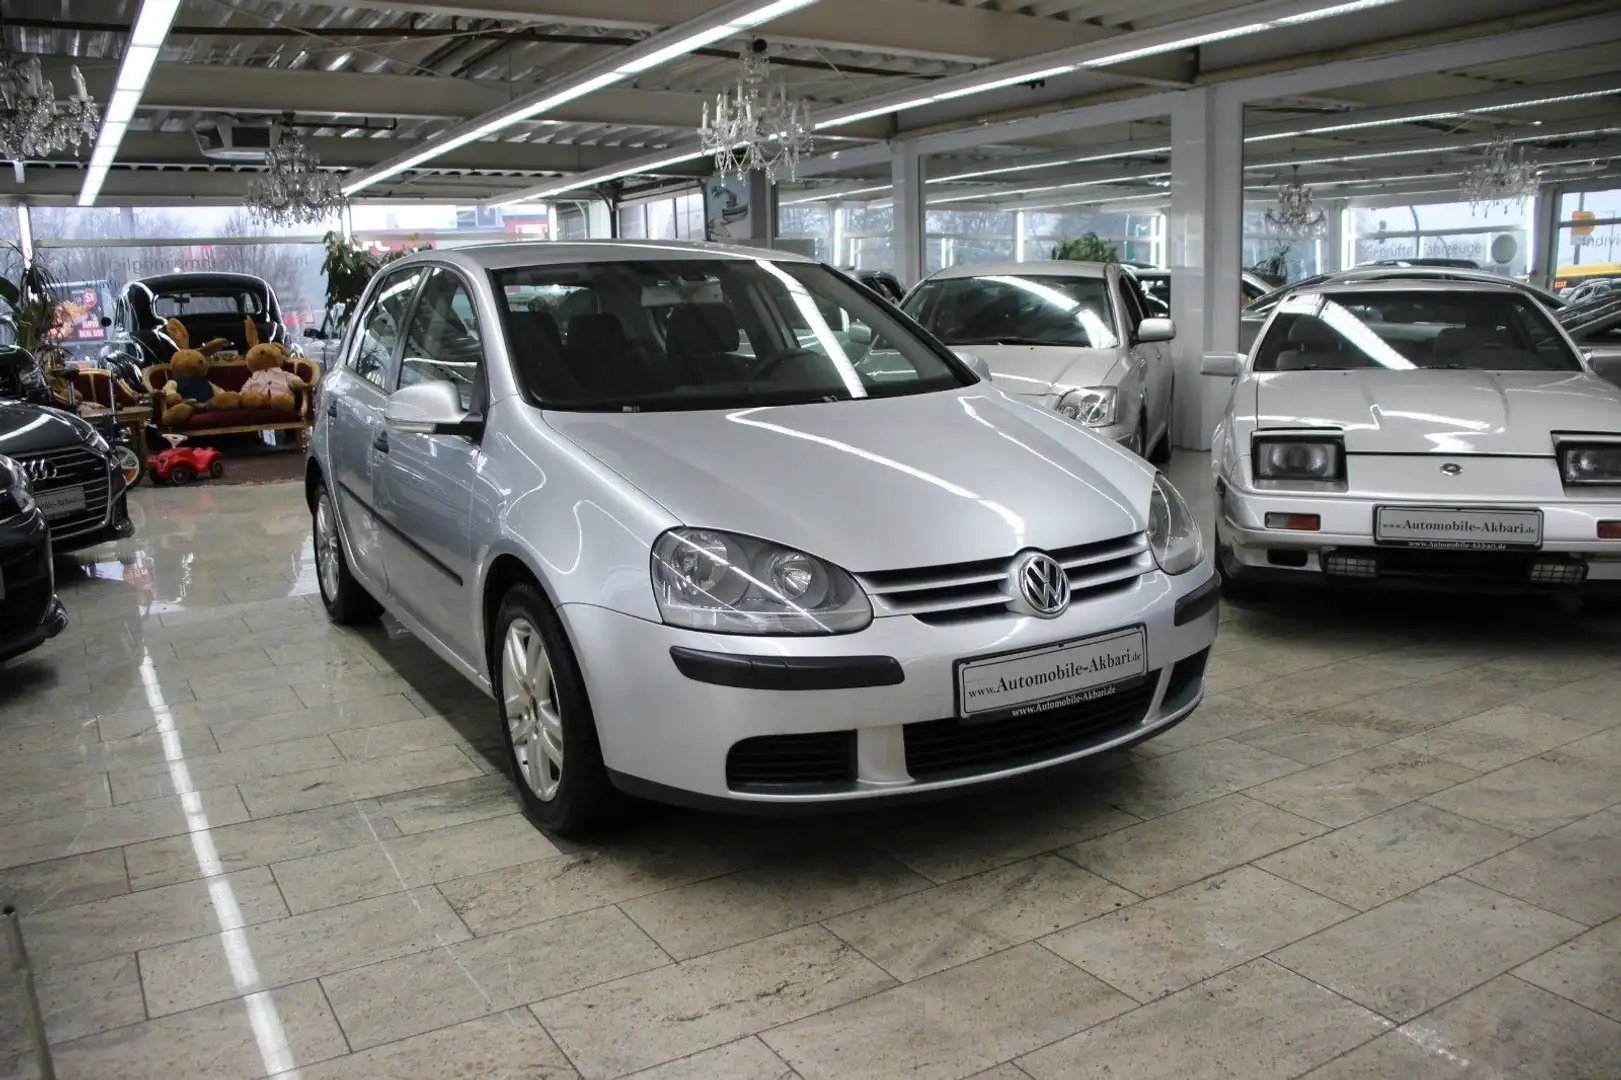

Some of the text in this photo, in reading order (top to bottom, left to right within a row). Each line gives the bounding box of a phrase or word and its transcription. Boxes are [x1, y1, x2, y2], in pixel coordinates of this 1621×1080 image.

[1382, 519, 1537, 535] www.Automobile-Akbari.de
[967, 649, 1142, 699] www.Automobile-Akbari.de
[1011, 685, 1117, 718] www.Automobile-Akbari.de
